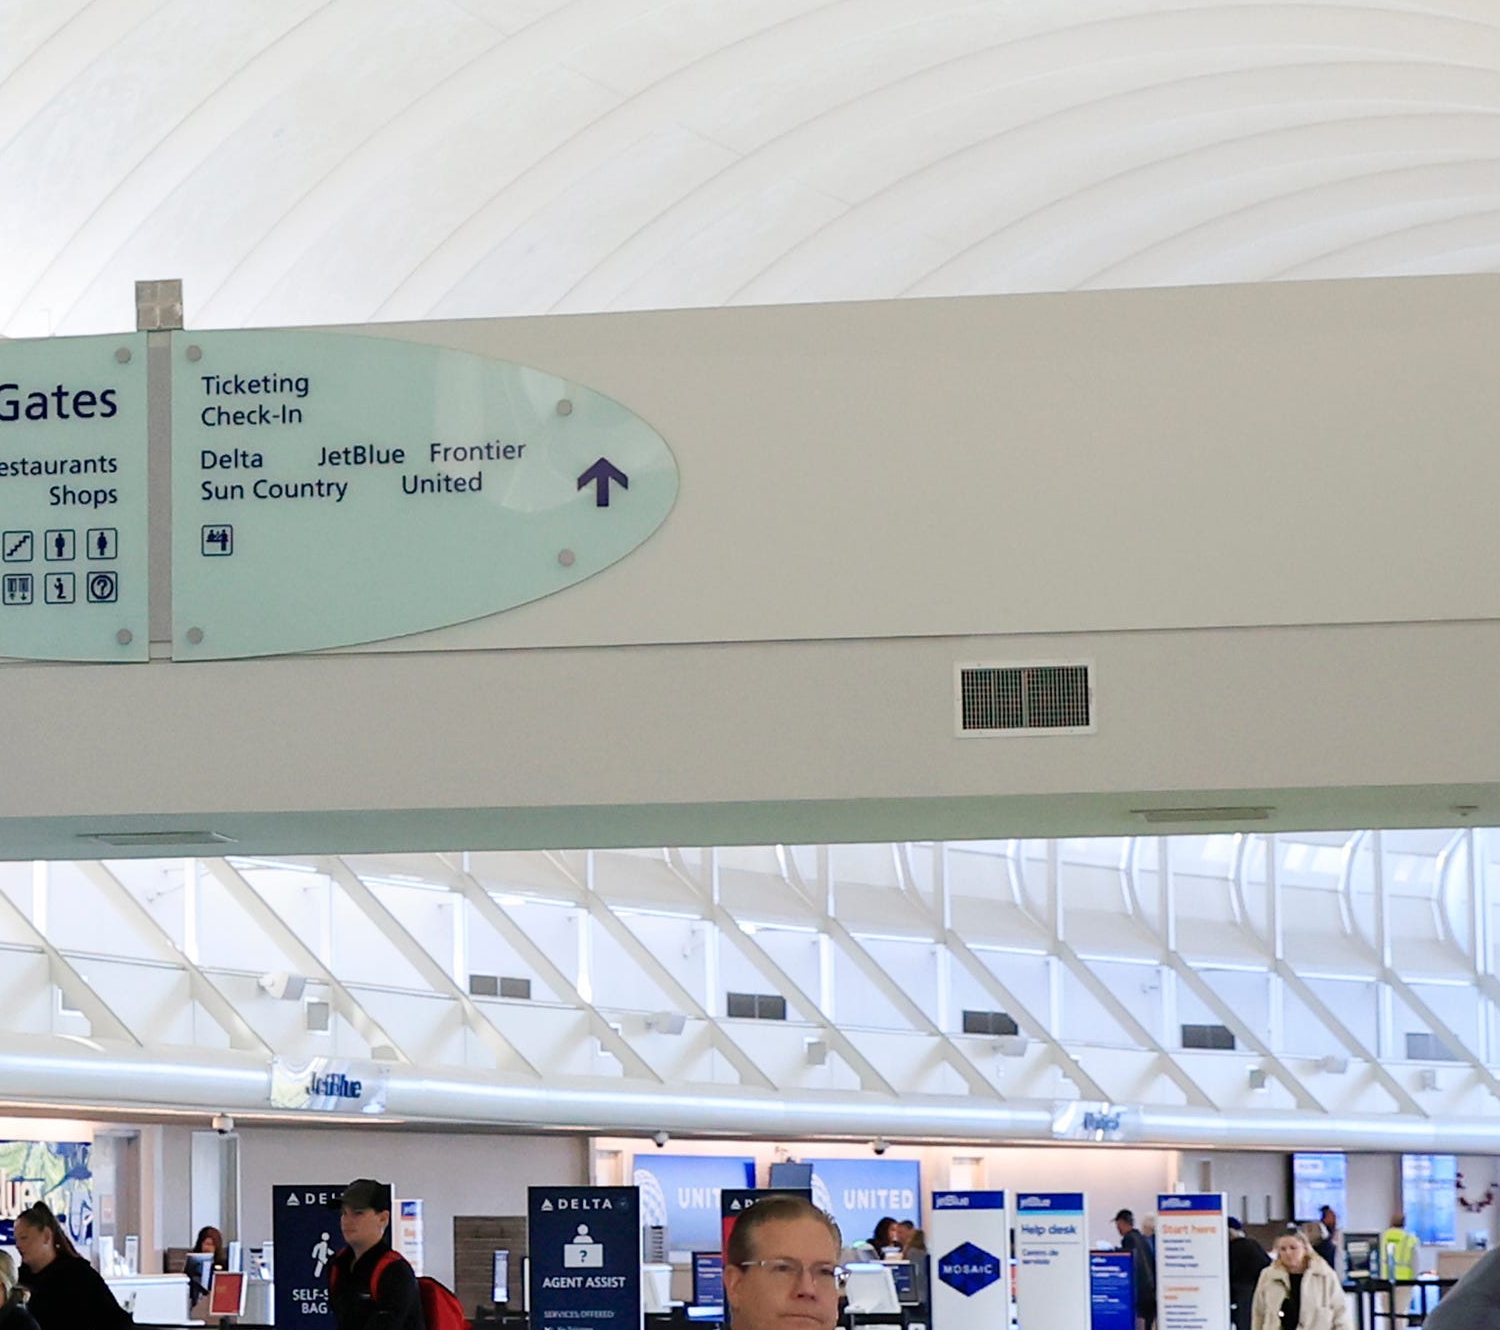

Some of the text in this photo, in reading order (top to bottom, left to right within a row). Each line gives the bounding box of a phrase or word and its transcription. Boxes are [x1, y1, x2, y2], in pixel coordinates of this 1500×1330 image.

[201, 373, 309, 398] Ticketing
[201, 404, 303, 427] Check-In
[201, 439, 527, 470] Delta JetBlue Frontier
[48, 485, 118, 509] Shops
[201, 471, 484, 503] Sun Country United
[557, 1198, 614, 1210] DELTA
[843, 1188, 914, 1210] UNITED
[942, 1263, 994, 1275] MOSAIC
[542, 1276, 627, 1289] AGENT ASSIST
[300, 1302, 329, 1315] BAG
